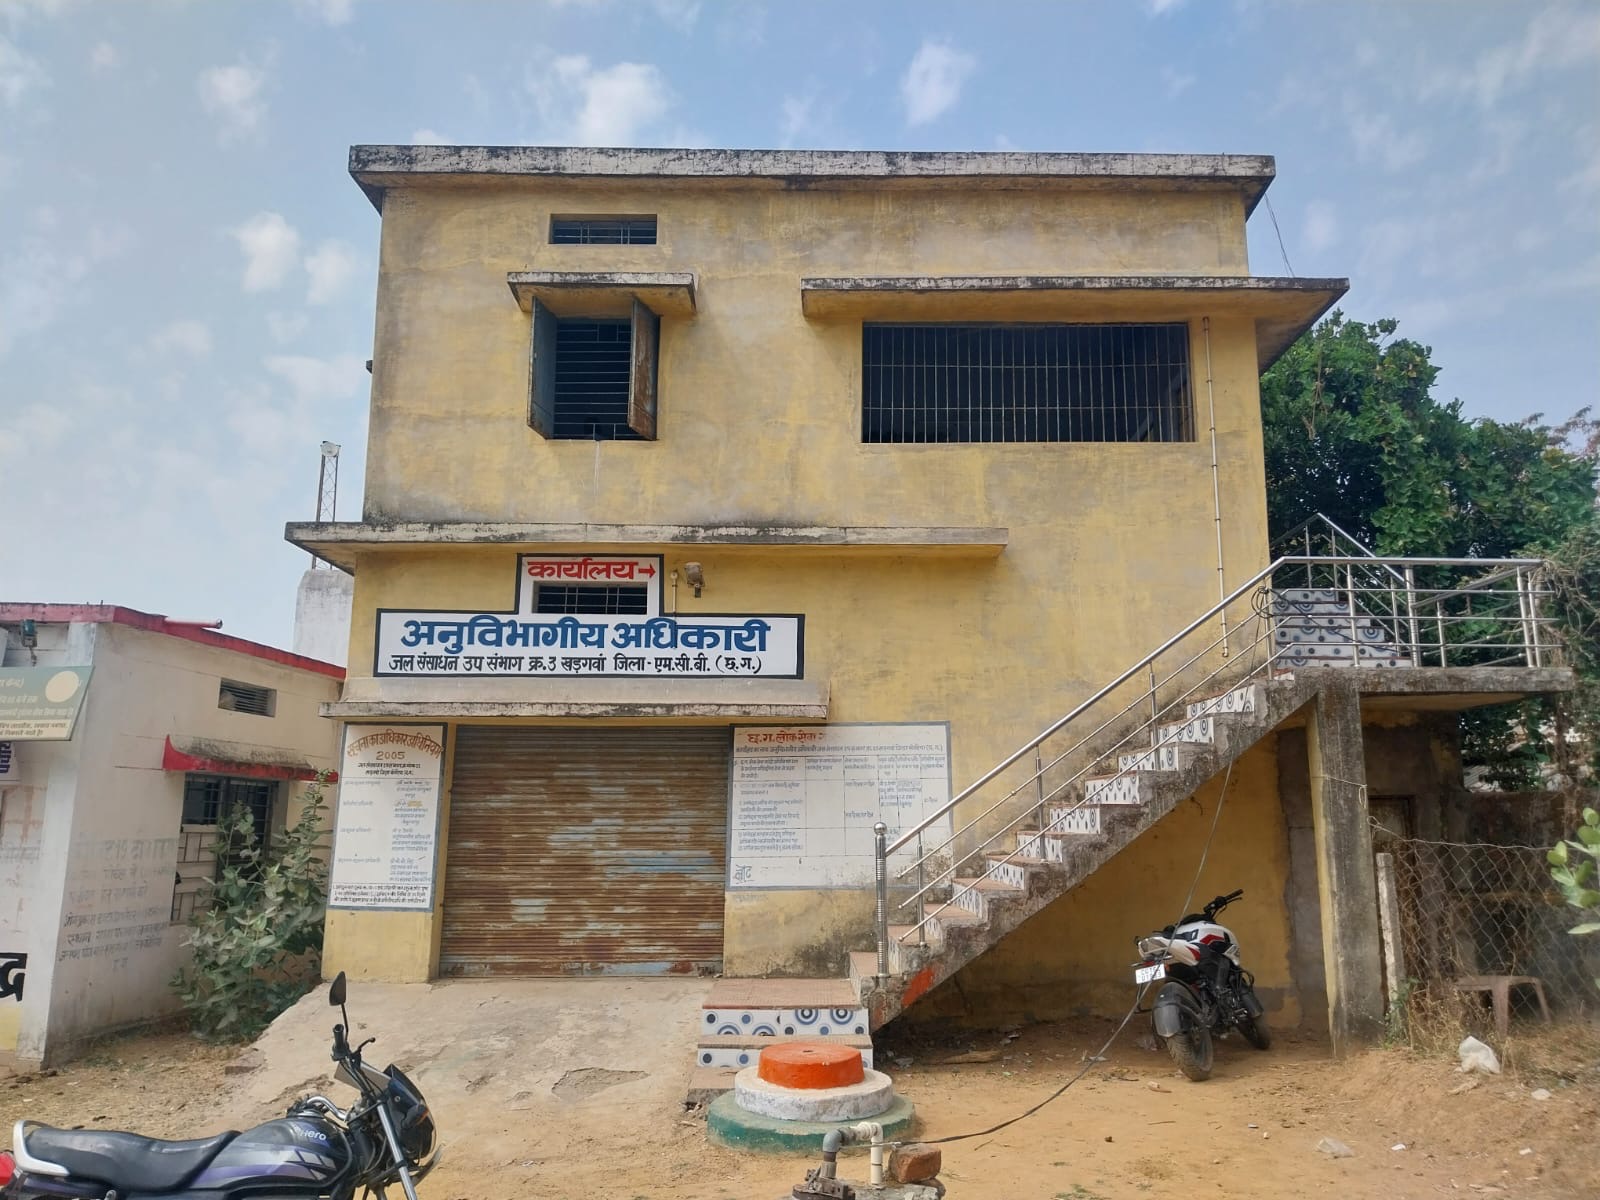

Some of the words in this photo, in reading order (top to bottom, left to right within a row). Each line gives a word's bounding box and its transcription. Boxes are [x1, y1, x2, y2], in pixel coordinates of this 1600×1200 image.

[527, 557, 639, 580] कार्यालय
[400, 614, 609, 655] अनुविभागीय
[610, 617, 772, 653] अधिकारी
[388, 654, 415, 672] जल
[416, 651, 460, 671] संसाधन
[462, 655, 485, 672] उप
[486, 652, 525, 672] संभाग
[561, 653, 607, 674] खड़गवां
[375, 751, 406, 761] 2005
